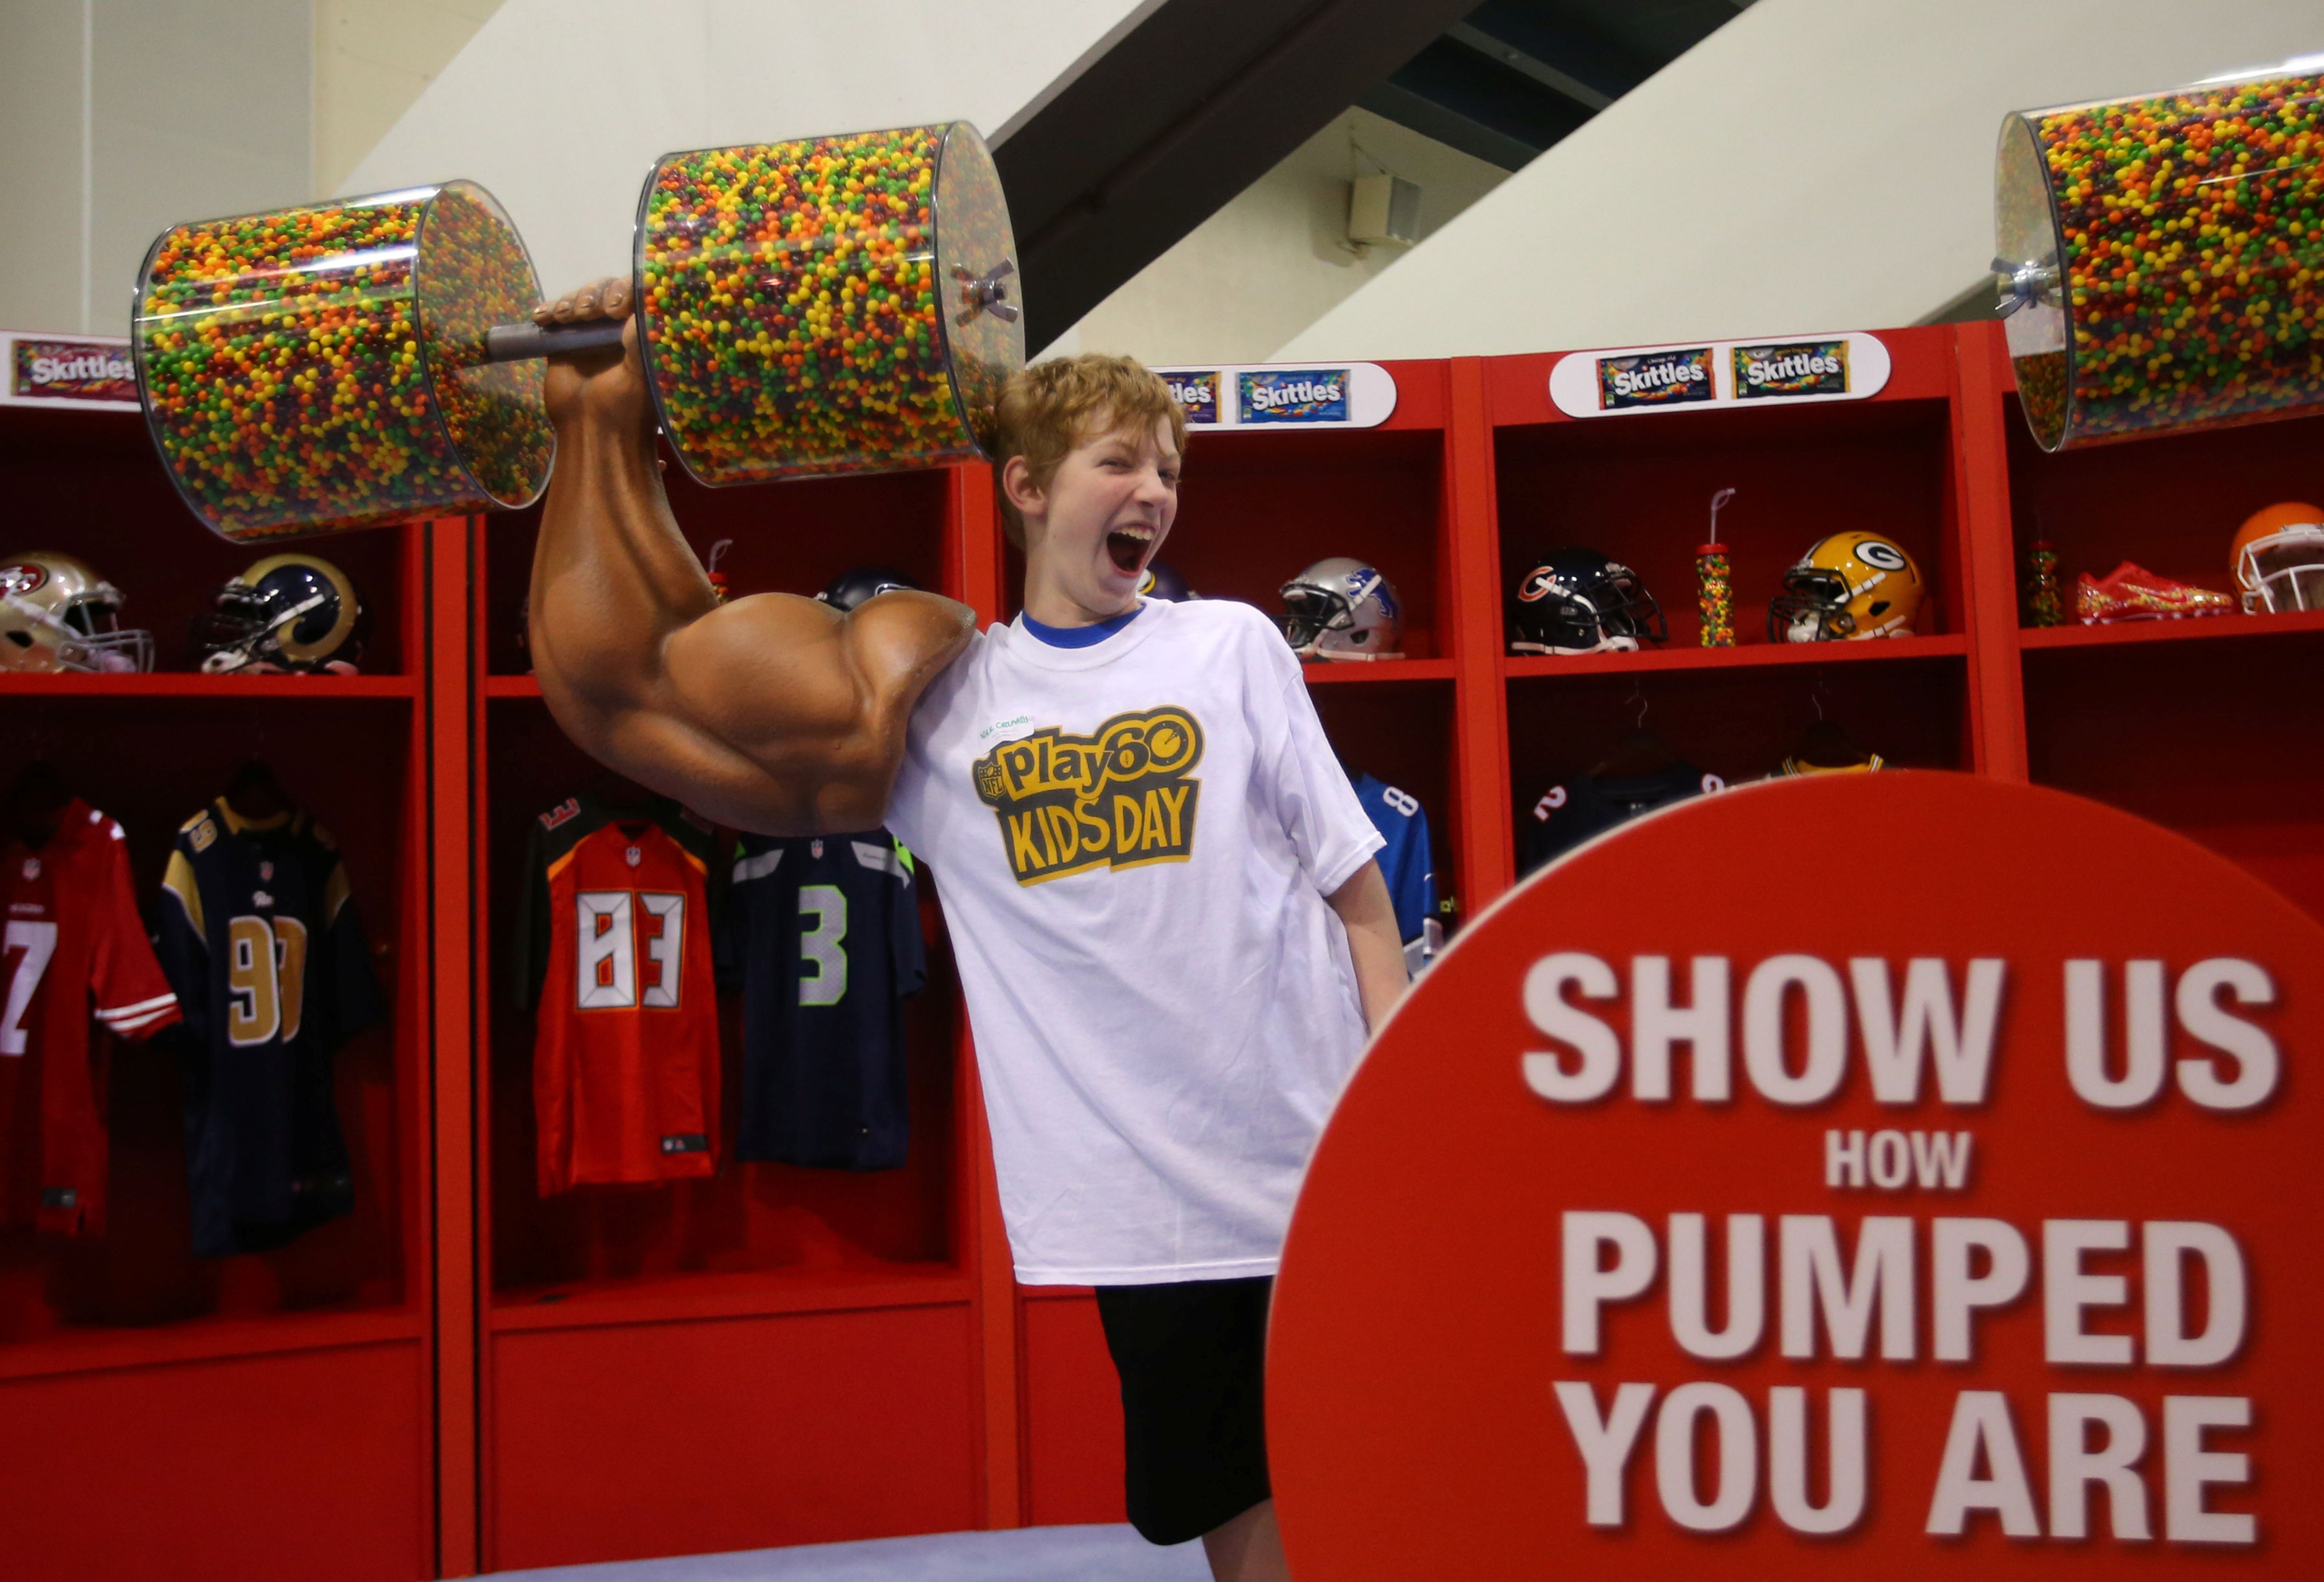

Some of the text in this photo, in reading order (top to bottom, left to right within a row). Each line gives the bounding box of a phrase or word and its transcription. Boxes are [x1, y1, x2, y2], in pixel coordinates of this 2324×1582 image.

[1252, 381, 1341, 411] Skittles
[1614, 362, 1705, 396] Skittles
[1747, 353, 1839, 385] Skittles
[1008, 786, 1189, 873] KIDS DAY
[575, 889, 687, 1013] 83
[798, 885, 847, 1006] 3
[1522, 951, 2279, 1109] SHOW US
[1825, 1130, 1972, 1189] HOW
[1561, 1211, 2246, 1367] PUMPED
[1552, 1381, 2256, 1543] YOU ARE
